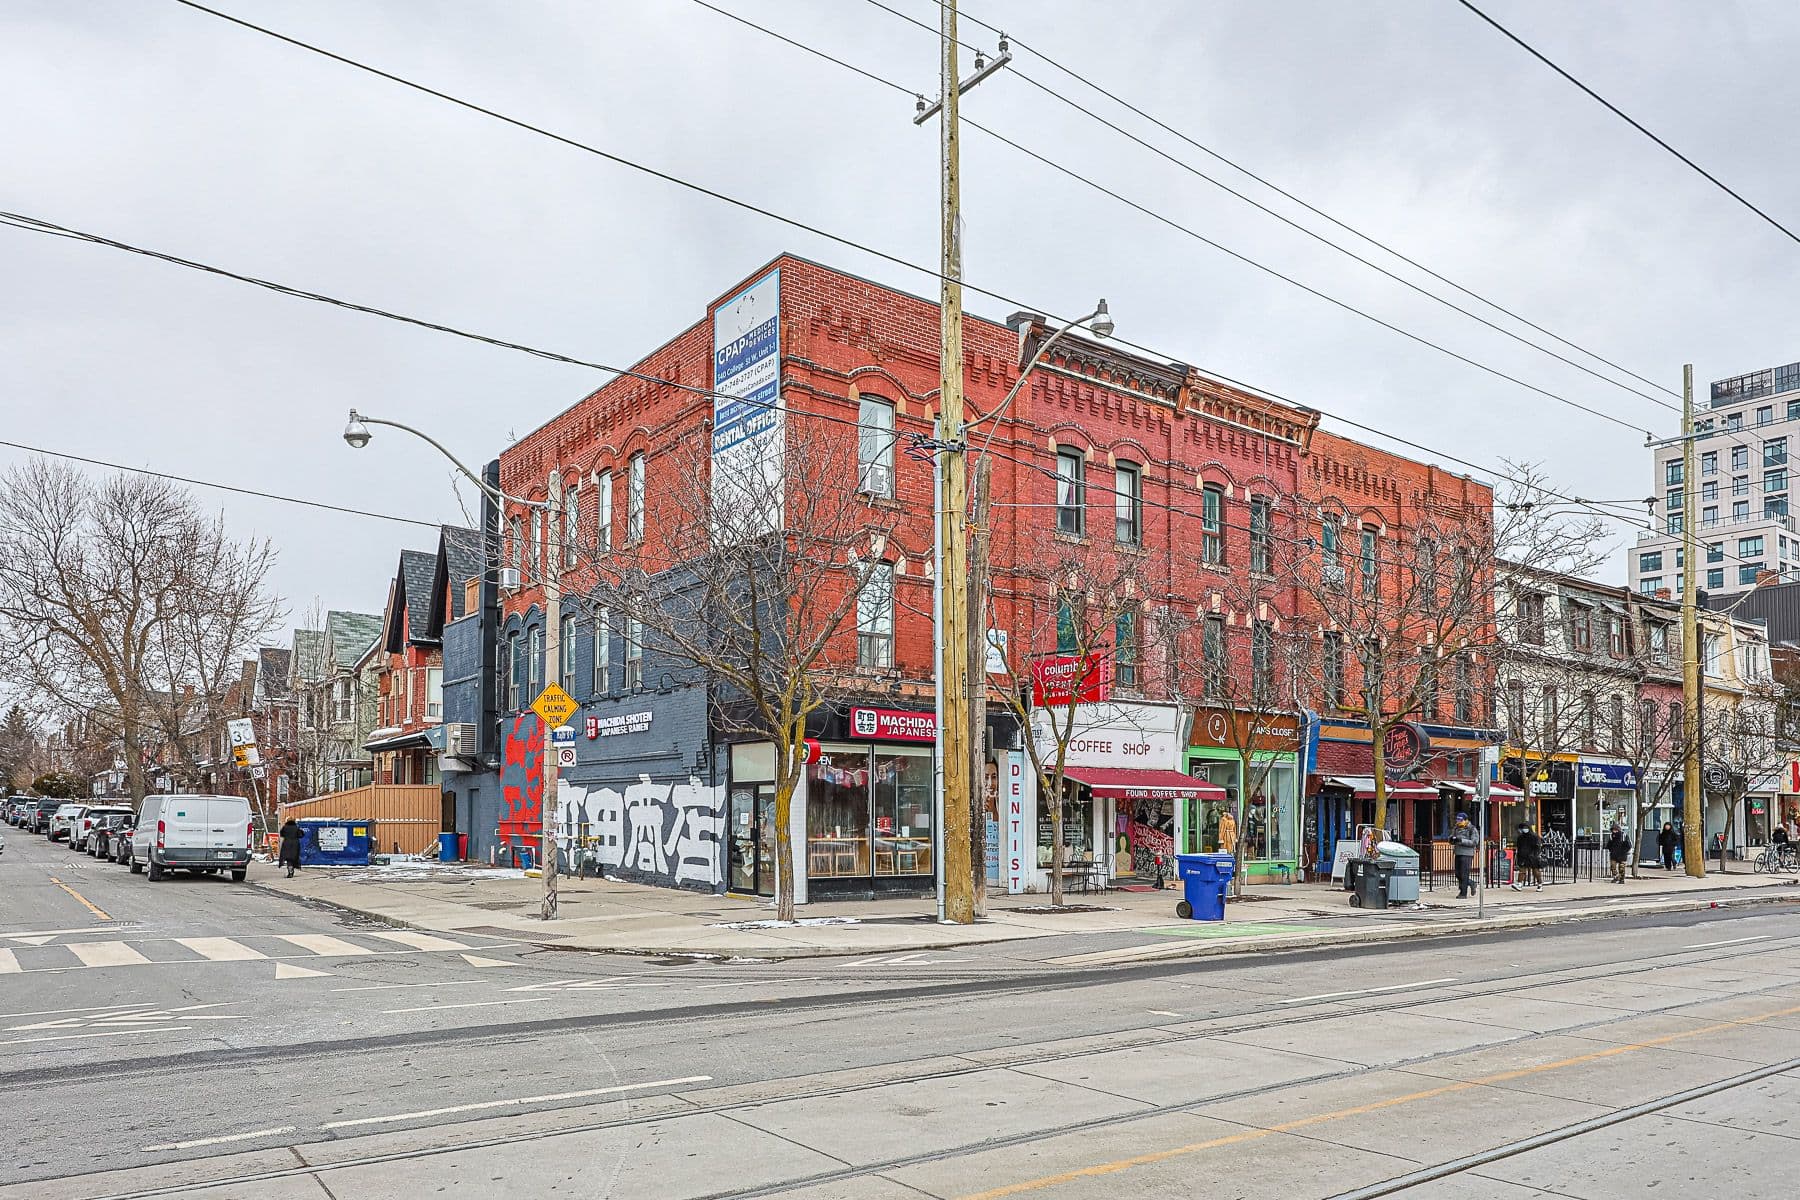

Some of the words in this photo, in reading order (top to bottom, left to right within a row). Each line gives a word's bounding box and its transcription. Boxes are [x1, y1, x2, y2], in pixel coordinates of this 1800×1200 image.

[749, 319, 775, 340] MEDICAL
[749, 327, 776, 348] DEVICES
[718, 338, 745, 365] CPAP
[714, 424, 746, 450] DENTAL
[747, 409, 776, 434] OFFICE
[543, 694, 566, 703] TRAFFIC
[543, 704, 567, 713] CALMING
[549, 715, 562, 723] ZONE
[597, 715, 626, 729] MACHIDA
[626, 711, 653, 724] SHOTEN
[880, 715, 934, 729] MACHIDA
[601, 725, 628, 737] JAPANESE
[628, 722, 649, 733] RAMEN
[1069, 740, 1113, 753] COFFEE
[1123, 743, 1151, 756] SHOP
[1125, 789, 1148, 797] FOUND
[1151, 790, 1178, 798] COFFEE
[1010, 764, 1020, 890] DENTIST
